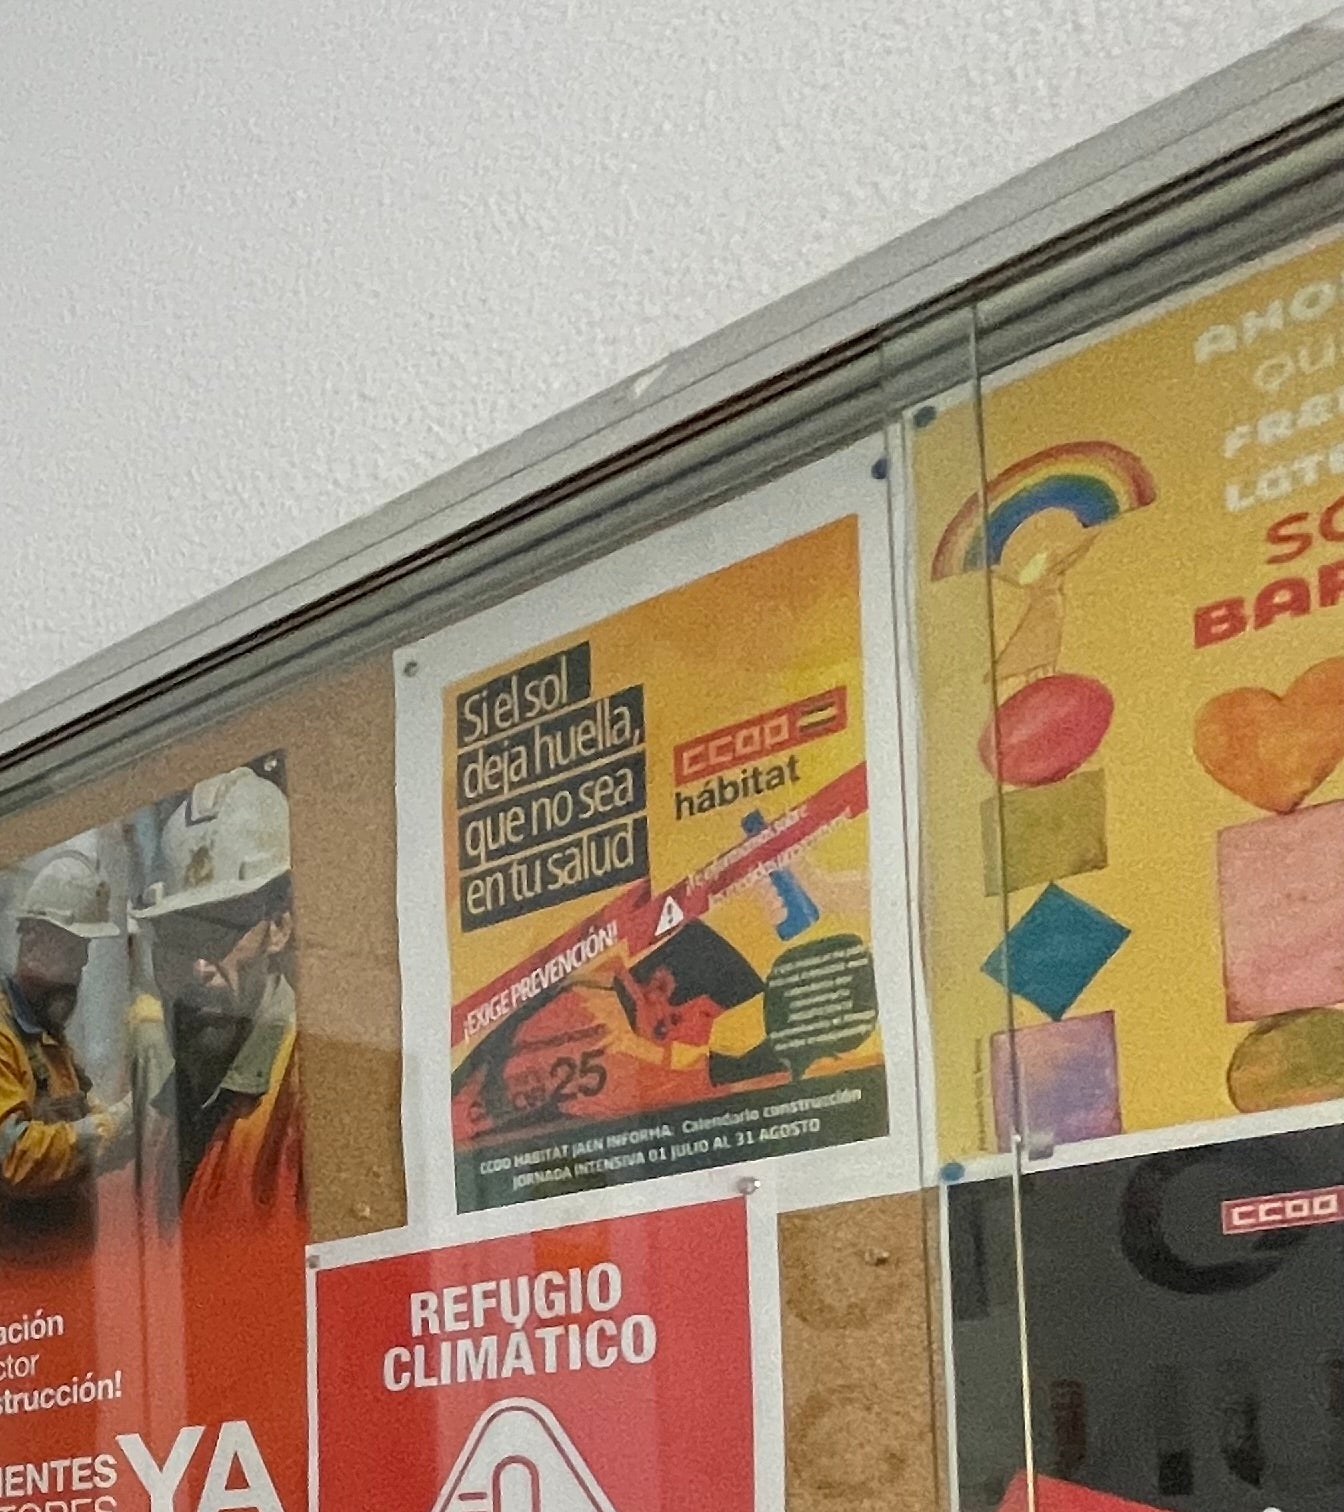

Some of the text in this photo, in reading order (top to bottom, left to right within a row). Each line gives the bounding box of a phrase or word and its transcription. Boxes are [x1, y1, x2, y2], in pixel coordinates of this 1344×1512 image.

[1194, 271, 1344, 364] AHO
[1253, 334, 1344, 393] QU
[463, 655, 568, 743] Si el sol
[463, 697, 641, 799] deja huella,
[681, 714, 790, 776] CCOO
[465, 767, 634, 867] que no sea
[675, 754, 800, 821] hábitat
[466, 873, 504, 915] en
[511, 859, 541, 903] tu
[546, 824, 634, 891] salud
[463, 997, 512, 1043] ¡EXIGE
[511, 919, 619, 1009] PREVENCIÓN!
[550, 1048, 608, 1101] 25
[512, 1118, 821, 1191] JORNADA INTENSIVA 01 JULIO AL 31 AGOSTO
[682, 1108, 759, 1134] Calendario
[1231, 1194, 1337, 1227] CCOO
[410, 1262, 623, 1338] REFUGIO
[383, 1314, 657, 1392] CLIMÁTICO
